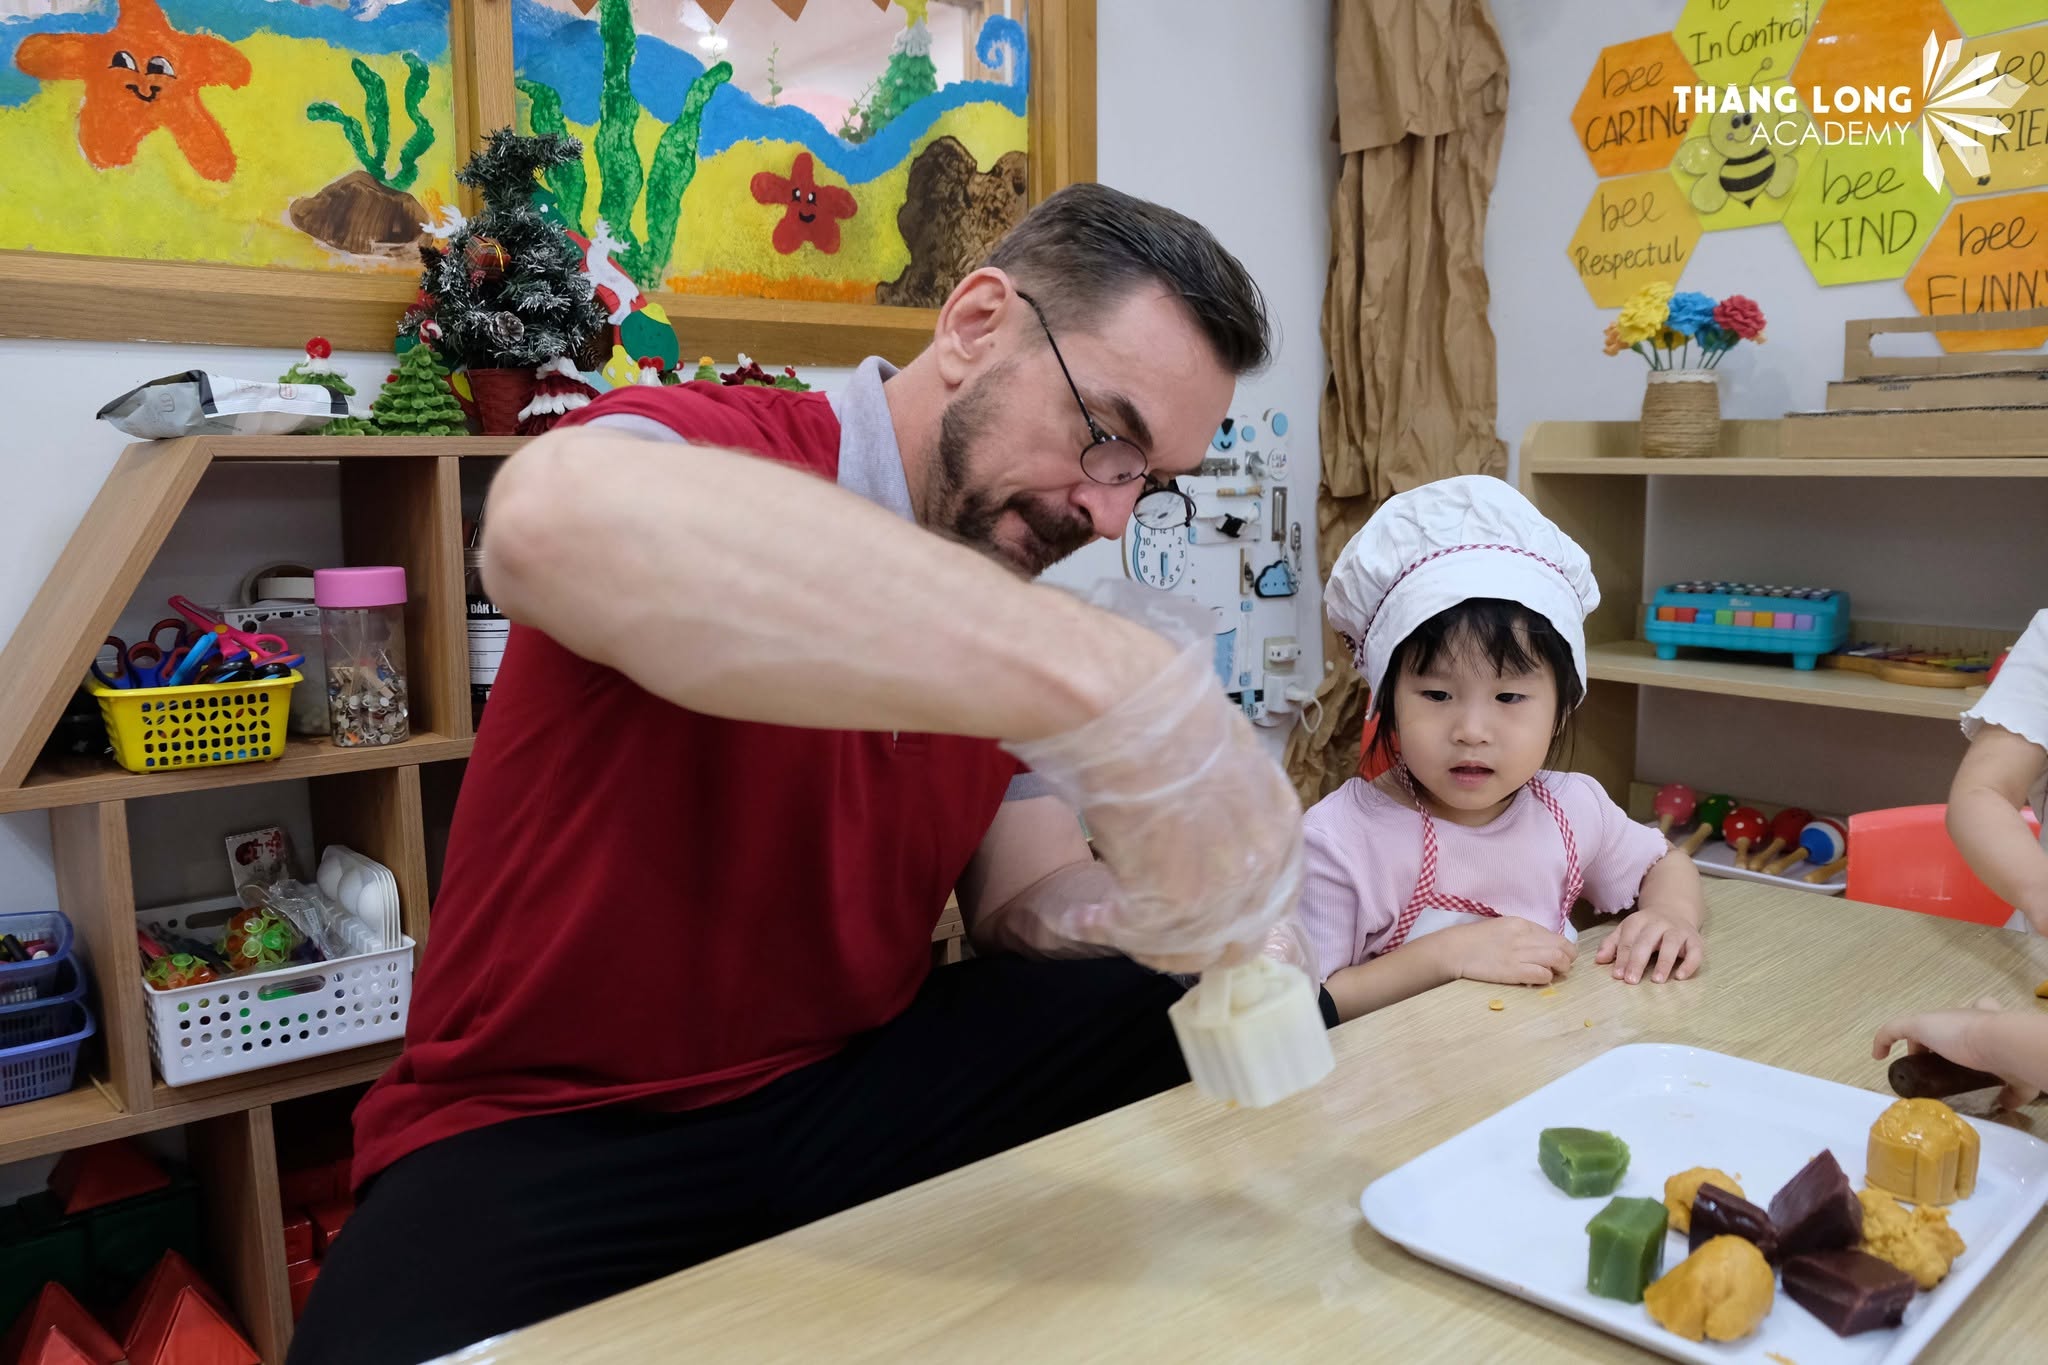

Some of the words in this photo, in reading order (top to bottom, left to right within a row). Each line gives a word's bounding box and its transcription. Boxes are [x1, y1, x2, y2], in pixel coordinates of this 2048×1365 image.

[1688, 31, 1723, 66] In
[1727, 1, 1810, 56] Control
[1602, 57, 1665, 99] bee
[1585, 97, 1690, 152] CARING
[1970, 107, 2048, 156] FRIE
[1821, 158, 1905, 205] bee
[1601, 191, 1667, 232] bee
[1814, 209, 1917, 262] KIND
[1959, 213, 2039, 257] bee
[1927, 269, 2048, 316] FUNN
[1143, 538, 1151, 546] 10
[1178, 537, 1182, 545] 2
[1180, 550, 1184, 558] 3
[1143, 565, 1148, 574] 8
[1160, 578, 1165, 586] 6
[1170, 574, 1174, 582] 5
